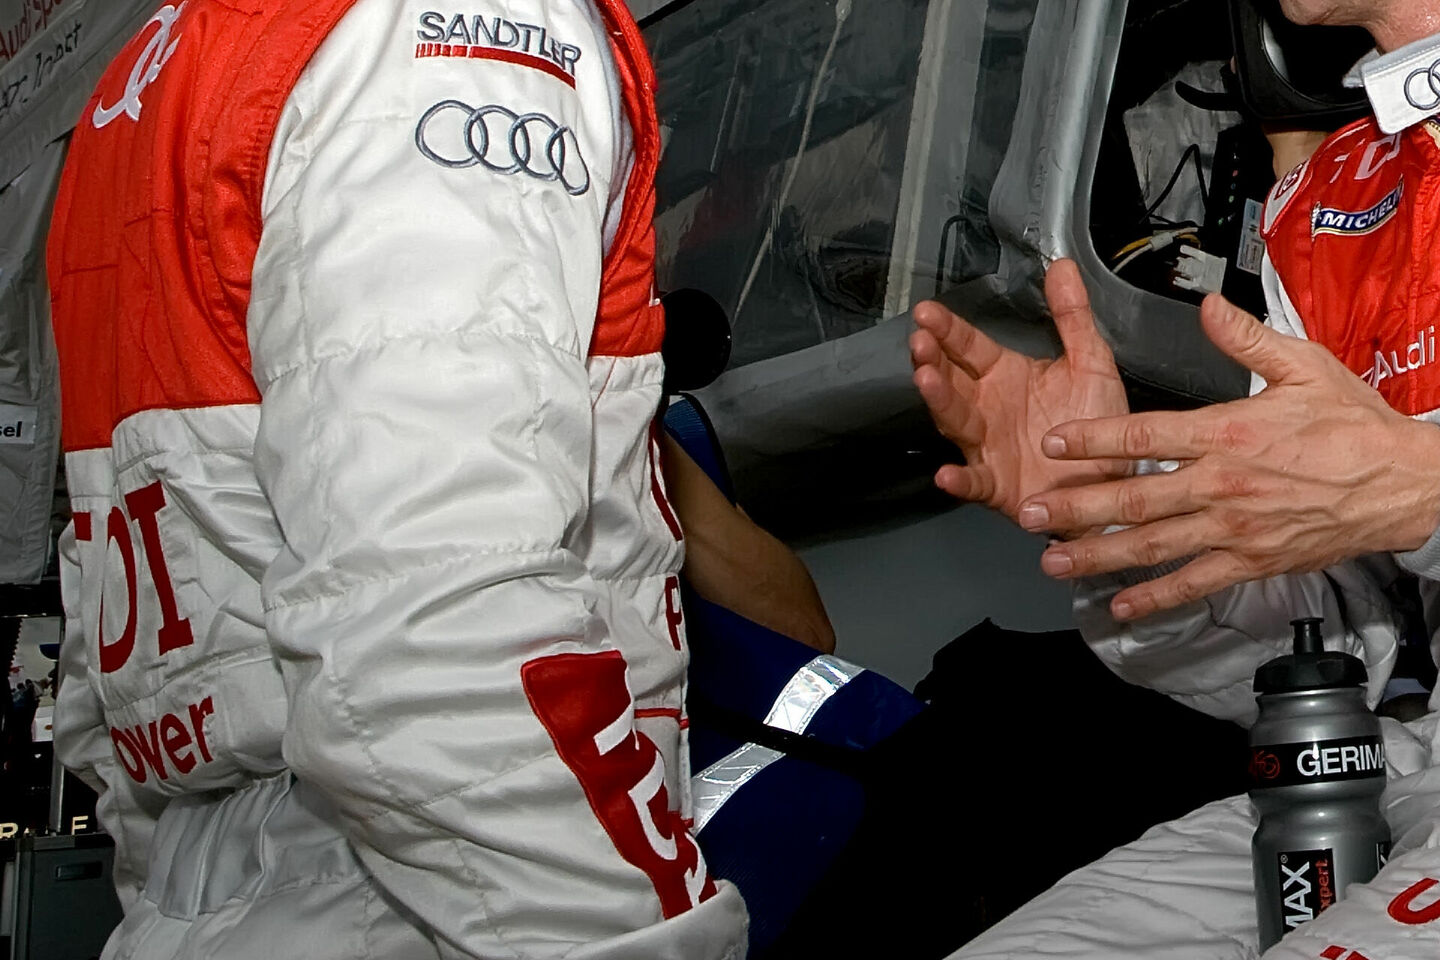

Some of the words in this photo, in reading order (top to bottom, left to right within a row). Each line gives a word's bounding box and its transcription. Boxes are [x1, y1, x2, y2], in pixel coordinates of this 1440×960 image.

[417, 11, 582, 71] SANDTLER
[1320, 190, 1400, 229] MICHELI
[1371, 325, 1435, 389] Audi
[109, 695, 215, 785] ower
[1315, 857, 1335, 912] xpert
